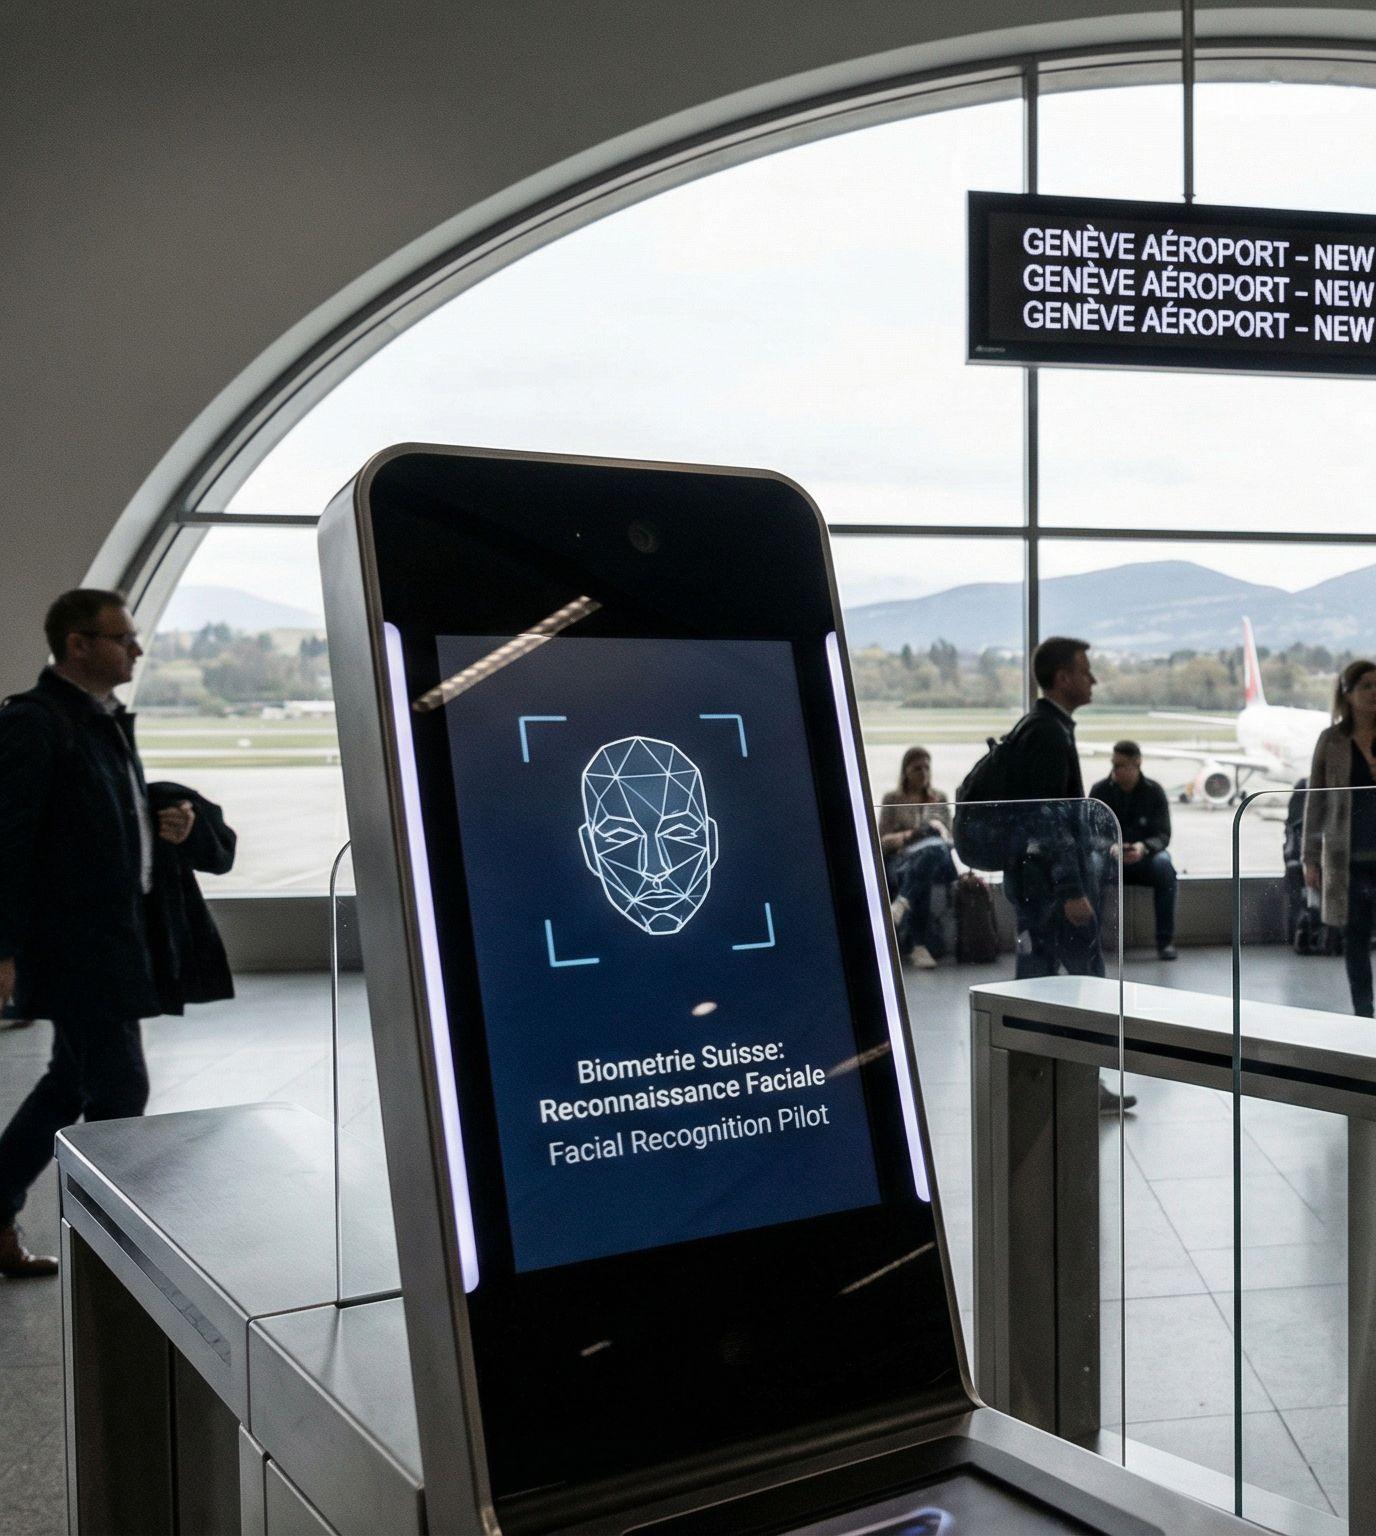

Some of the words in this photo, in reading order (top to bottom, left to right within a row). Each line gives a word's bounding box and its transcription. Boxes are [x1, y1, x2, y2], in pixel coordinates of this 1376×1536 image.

[1023, 224, 1135, 259] GENÈVE
[1141, 229, 1289, 267] AÉROPORT
[1315, 244, 1375, 272] NEW
[1023, 261, 1135, 295] GENÈVE
[1142, 265, 1290, 302] AÉROPORT
[1315, 279, 1374, 307] NEW
[1023, 297, 1135, 332] GENÈVE
[1141, 301, 1289, 338] AÉROPORT
[1315, 315, 1374, 343] NEW
[578, 1050, 695, 1083] Biometrie
[702, 1042, 784, 1068] Suisse:
[540, 1080, 740, 1123] Reconnaissance
[746, 1064, 825, 1094] Faciale
[550, 1132, 623, 1165] Facial
[631, 1116, 771, 1153] Recognition
[778, 1105, 829, 1130] Pilot
